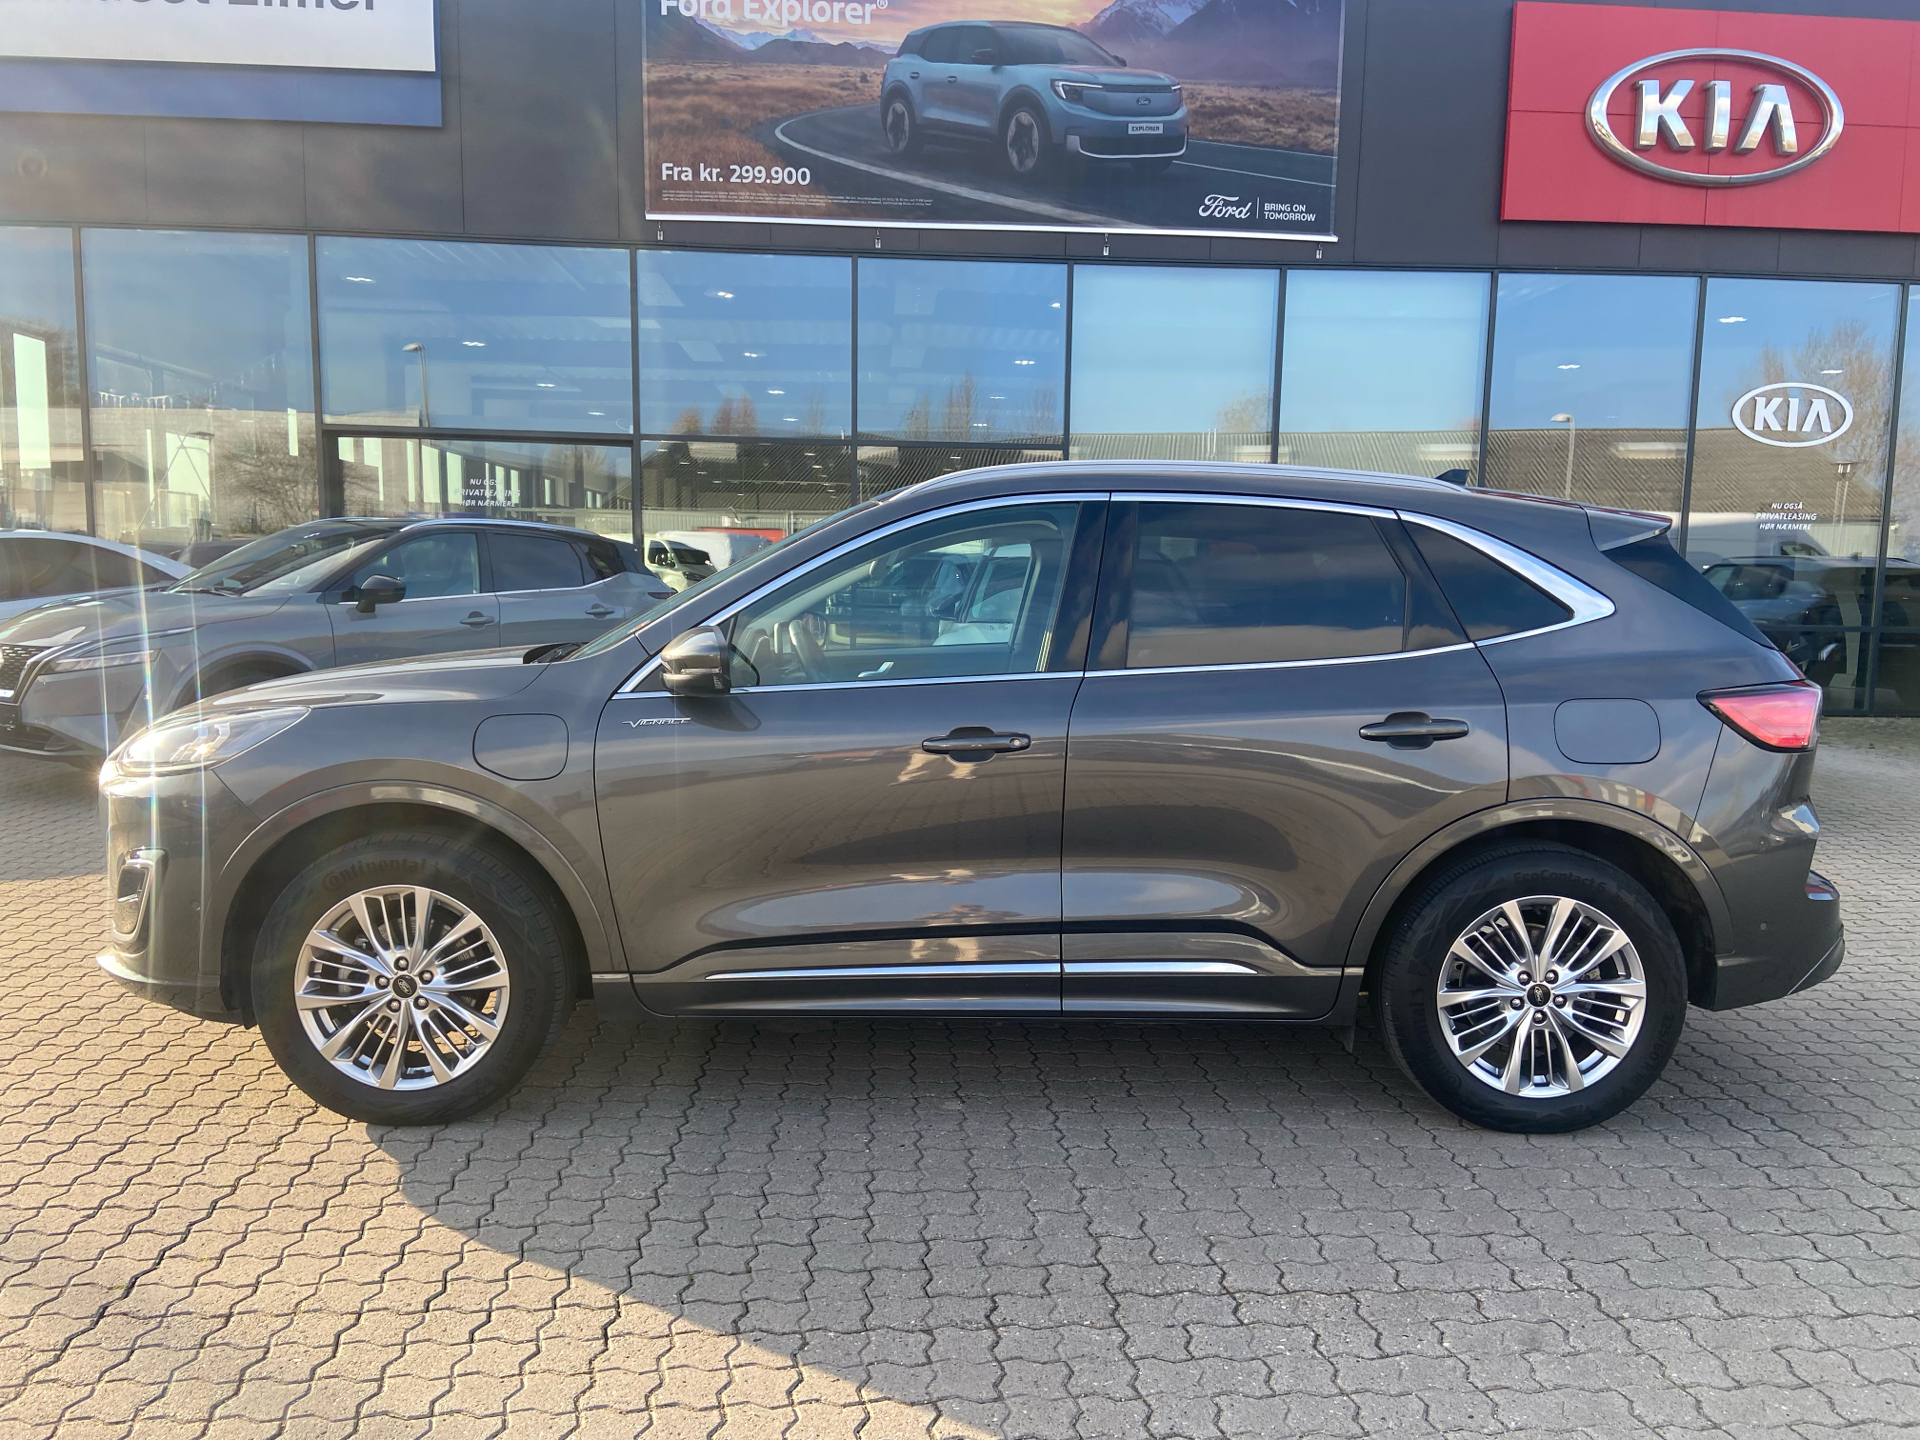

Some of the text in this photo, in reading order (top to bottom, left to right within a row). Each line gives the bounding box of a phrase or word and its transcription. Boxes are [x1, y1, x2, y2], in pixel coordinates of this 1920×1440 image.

[660, 0, 731, 17] Ford
[1633, 79, 1798, 156] KIA
[661, 162, 811, 185] Fra kr. 299.900
[1199, 194, 1253, 219] Ford
[1264, 203, 1306, 213] BRING ON
[1264, 211, 1316, 222] TOMORROW
[1753, 396, 1832, 432] KIA
[469, 478, 481, 486] NU
[454, 488, 521, 497] PRIVATLEAING
[1783, 501, 1803, 510] OGSÅ
[1755, 512, 1818, 521] PRIVATLEASING
[1759, 522, 1775, 530] HØR
[321, 857, 427, 892] Continental
[1513, 869, 1596, 889] EcoContact
